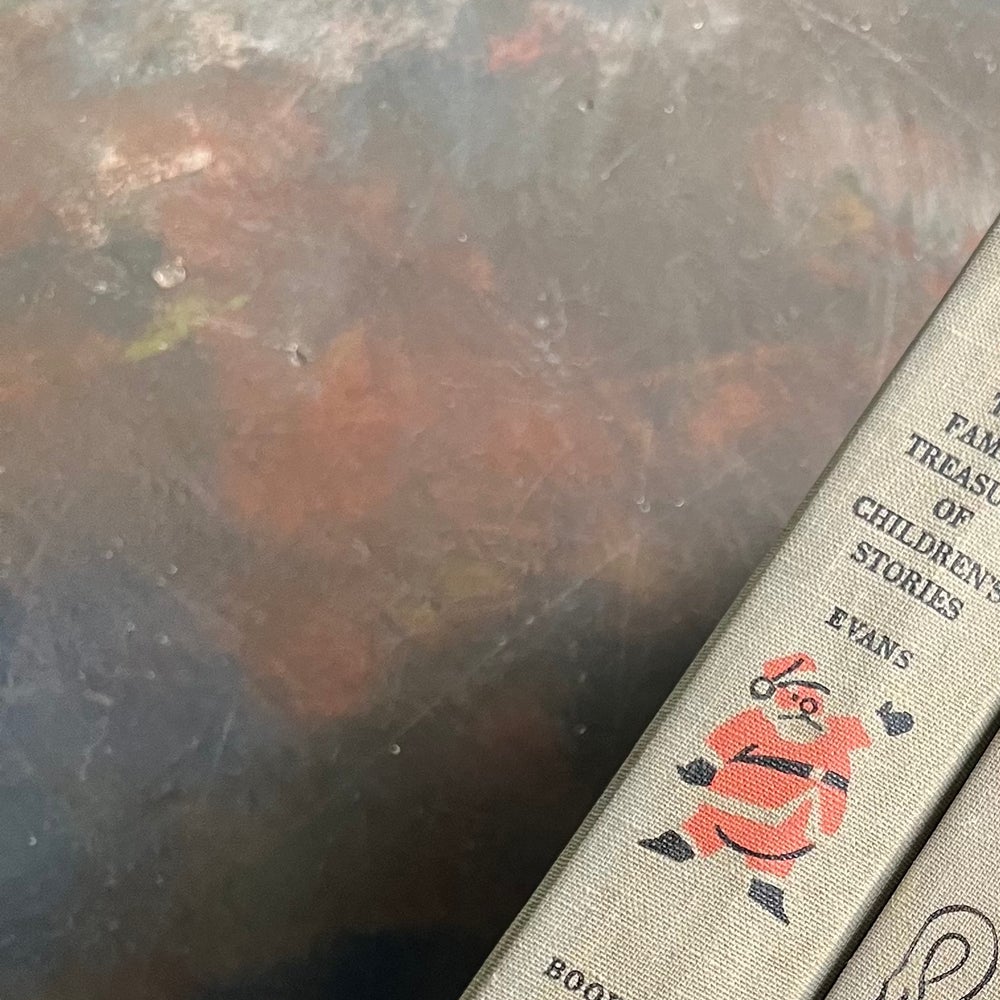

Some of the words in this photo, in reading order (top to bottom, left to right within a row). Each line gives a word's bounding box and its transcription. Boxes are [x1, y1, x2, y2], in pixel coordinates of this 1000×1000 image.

[933, 497, 975, 529] OF
[850, 541, 964, 621] STORIES
[825, 606, 914, 670] EVANS
